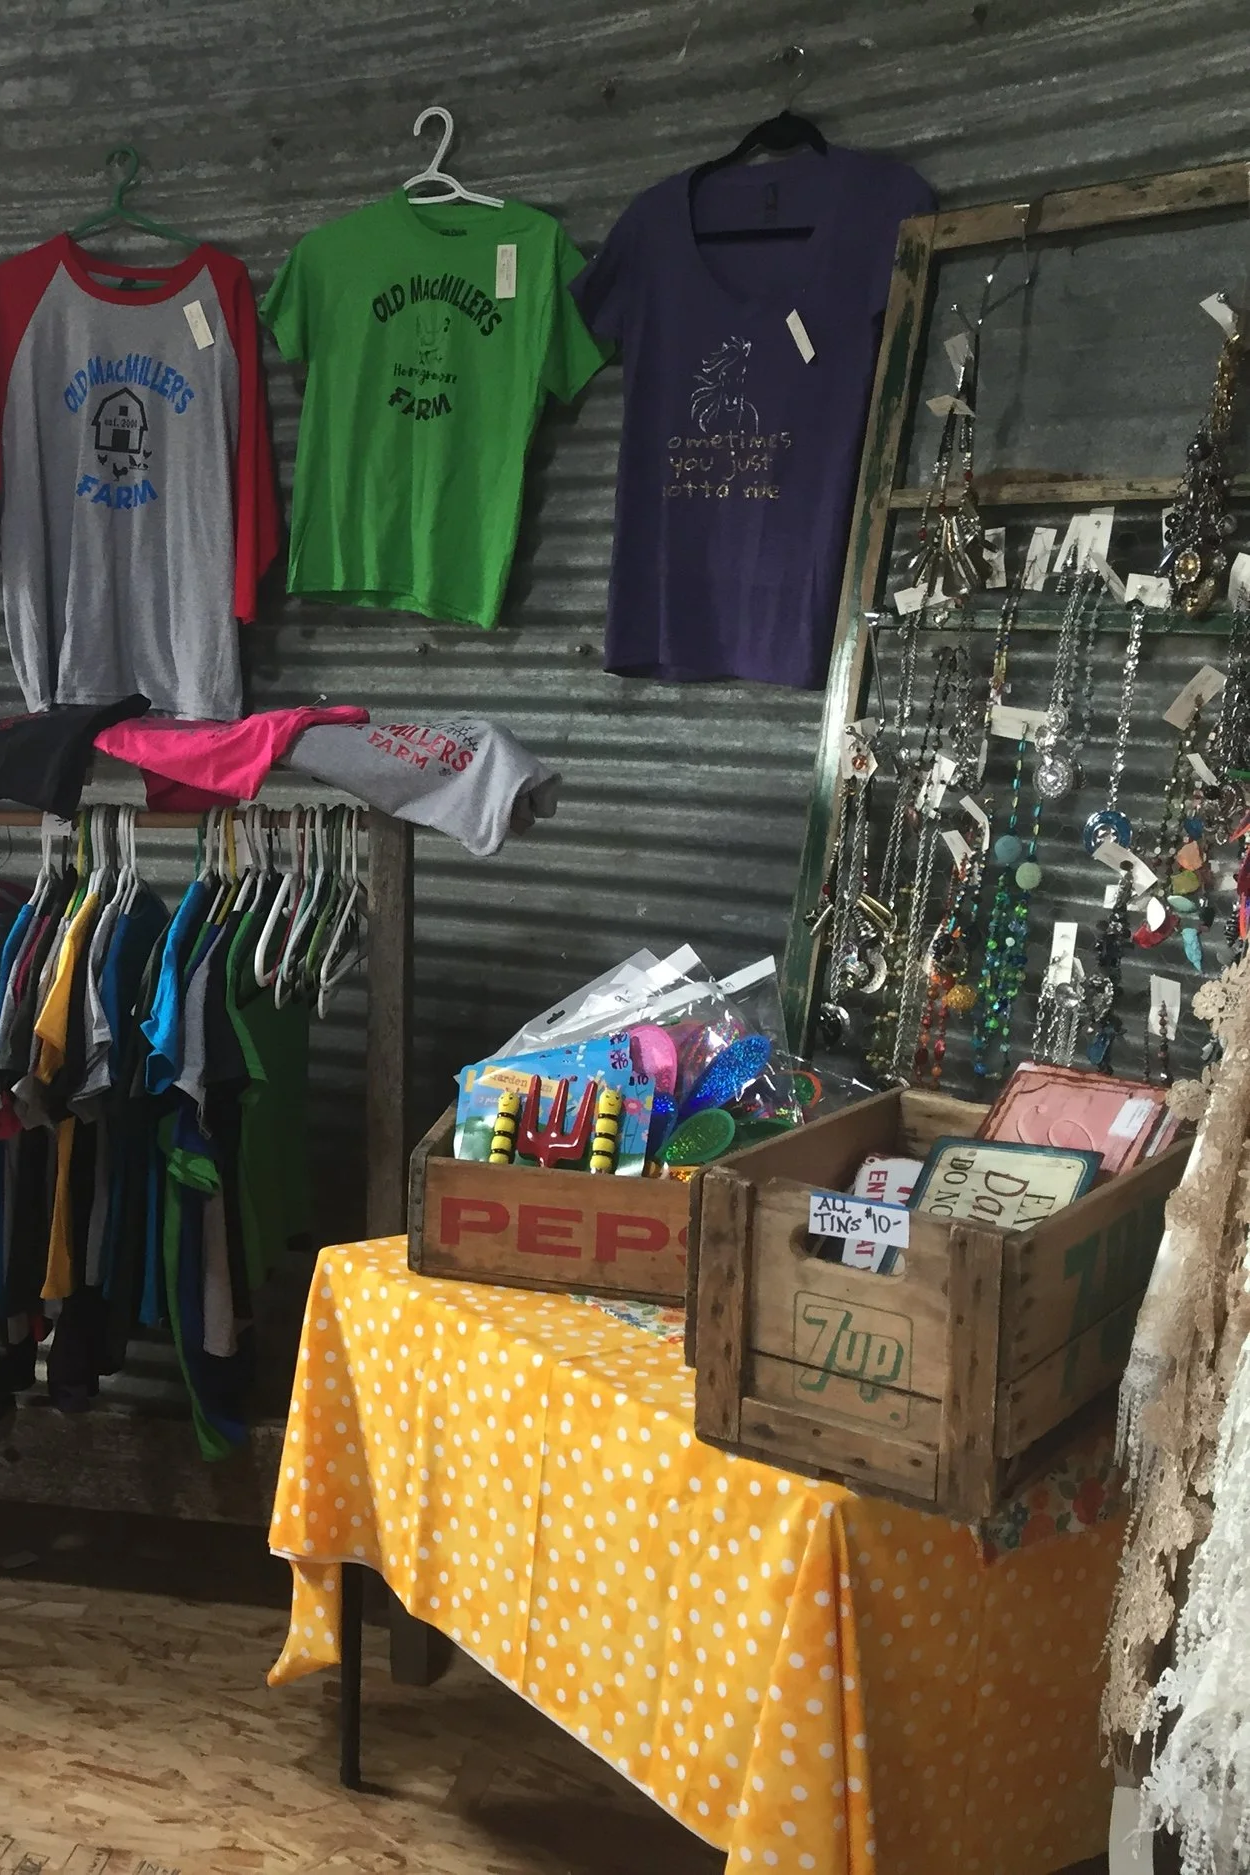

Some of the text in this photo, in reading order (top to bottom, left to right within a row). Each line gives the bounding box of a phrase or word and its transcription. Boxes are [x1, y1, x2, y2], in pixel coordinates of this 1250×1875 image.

[372, 283, 405, 323] OLD
[64, 369, 89, 413] OLD
[388, 387, 452, 421] FARM
[669, 451, 773, 482] you just
[76, 474, 159, 510] FARM
[367, 731, 430, 770] FARM
[488, 1074, 528, 1087] arden
[944, 1157, 975, 1185] DO
[817, 1197, 852, 1214] ALL
[440, 1196, 688, 1268] PEP
